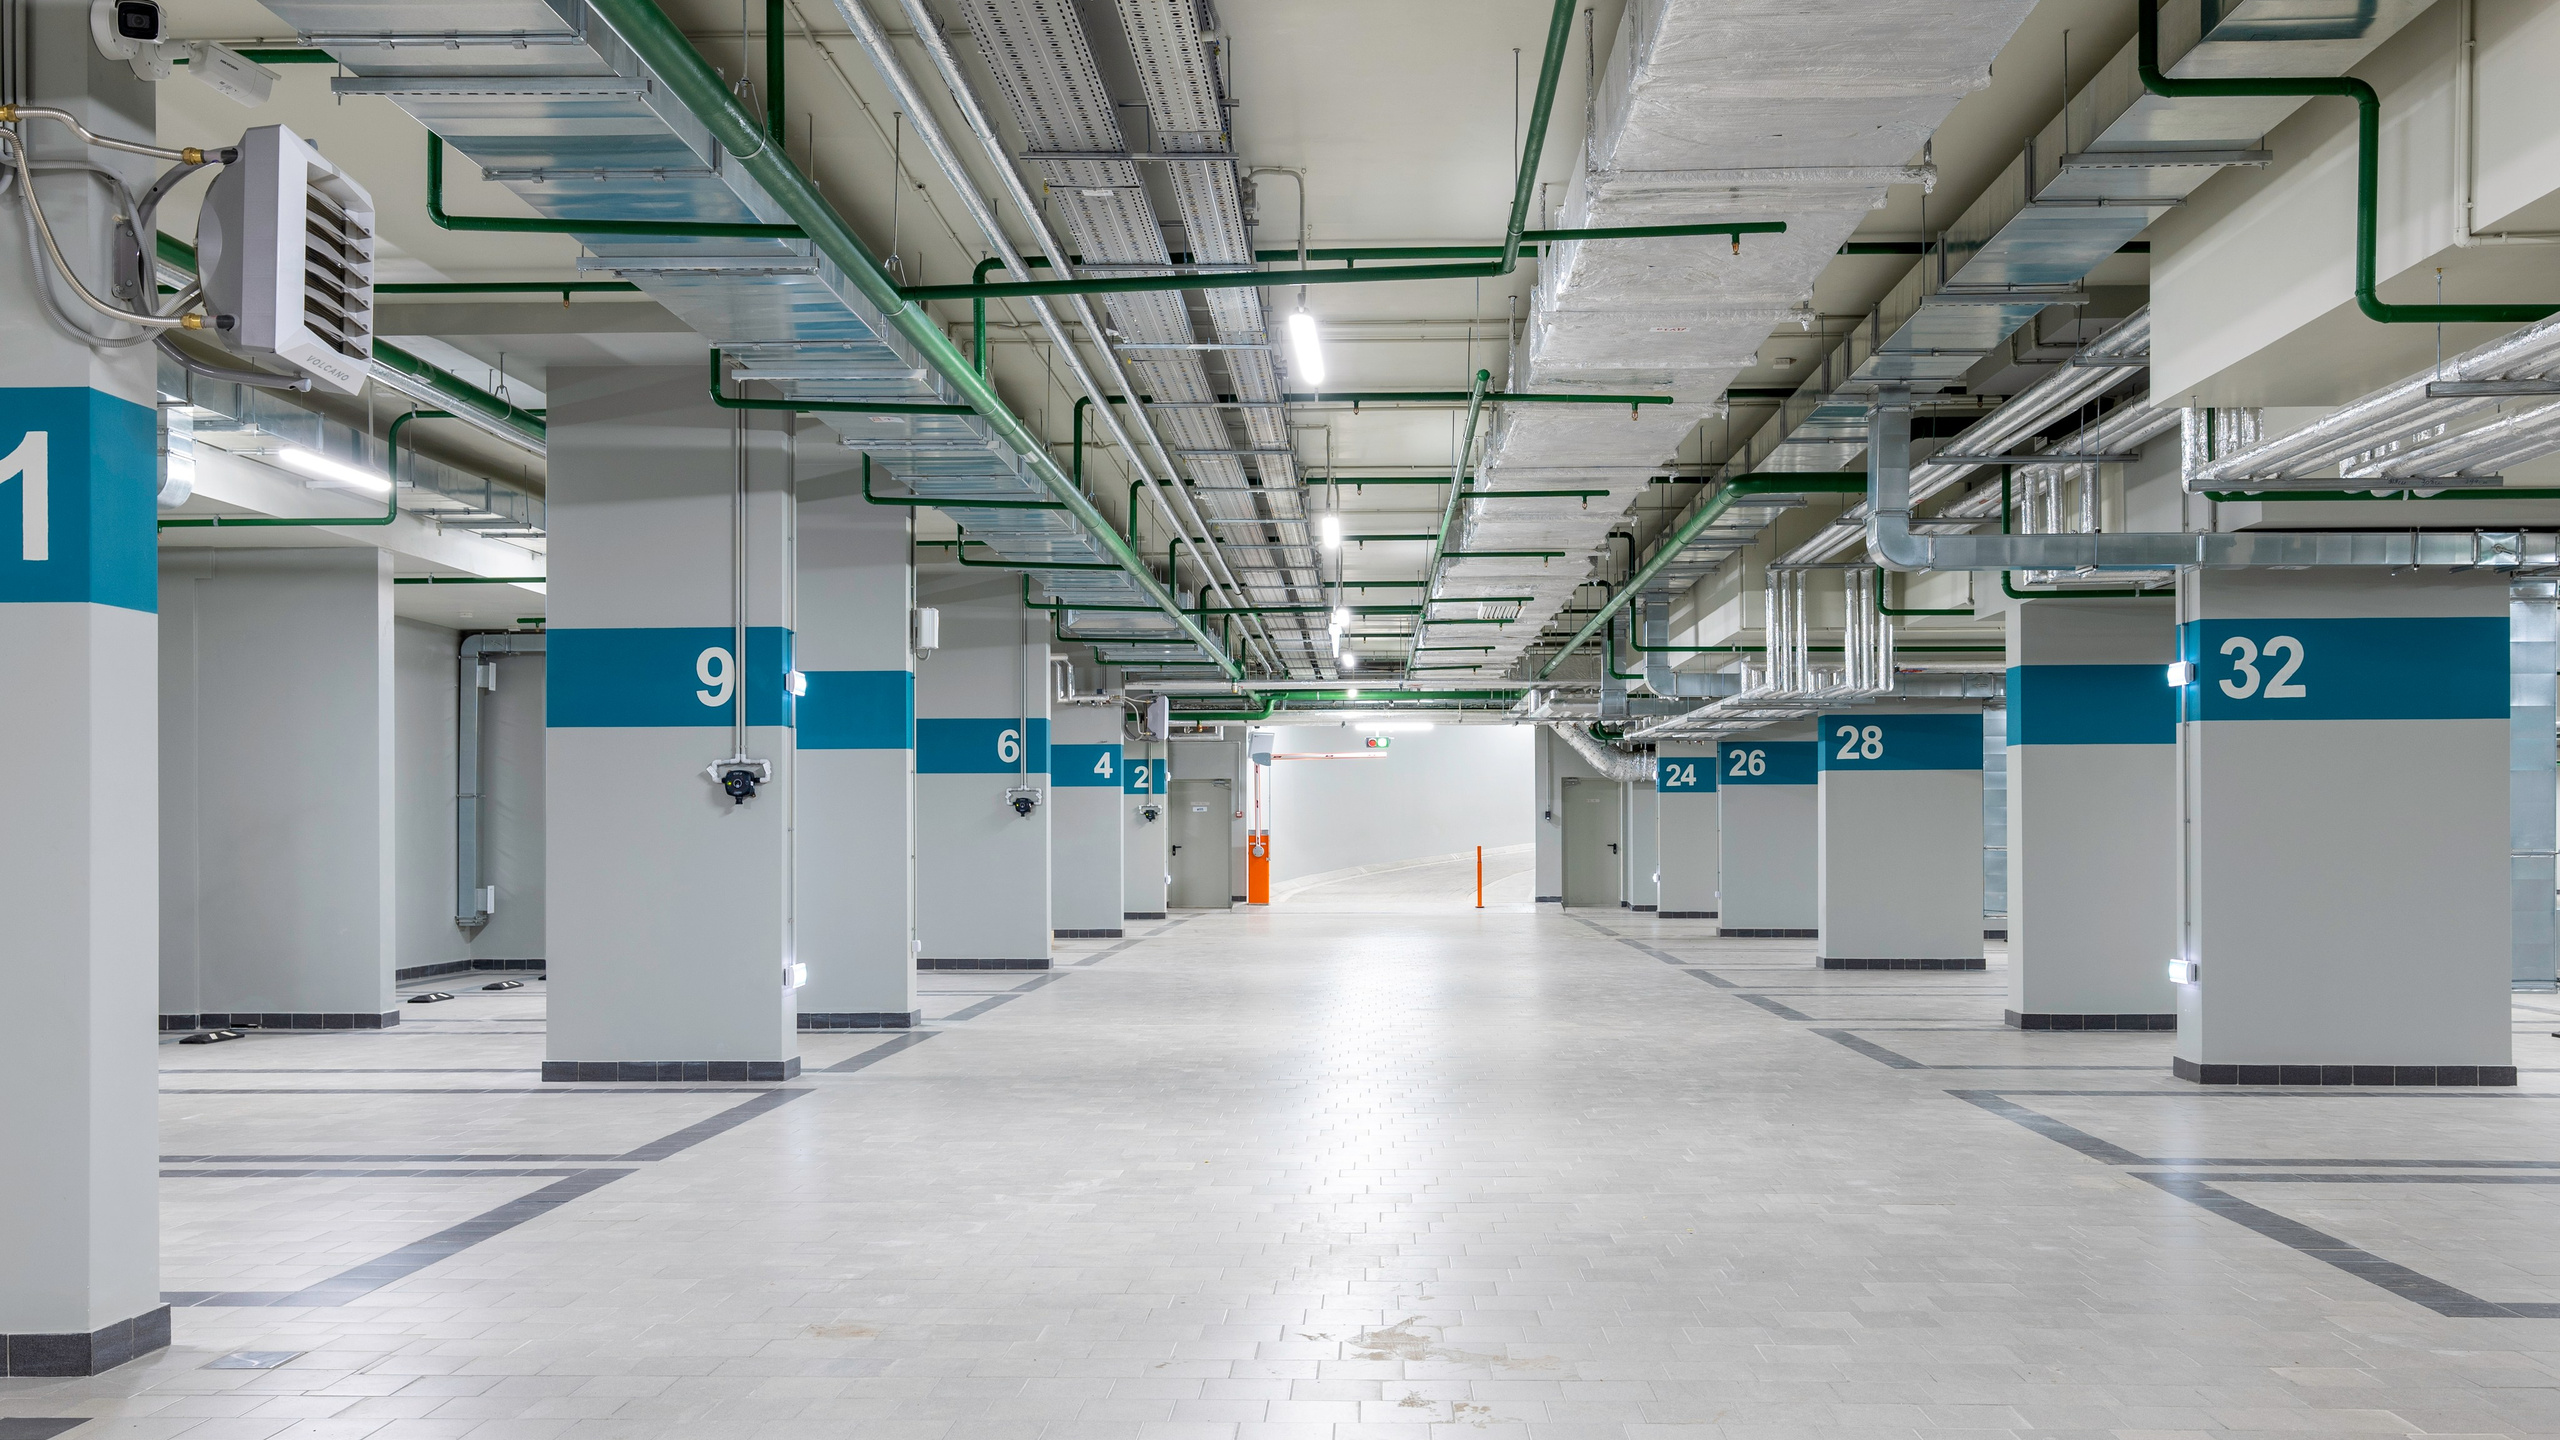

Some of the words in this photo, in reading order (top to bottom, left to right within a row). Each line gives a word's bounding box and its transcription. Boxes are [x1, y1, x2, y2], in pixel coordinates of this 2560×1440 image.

[306, 355, 350, 381] VOLCANO
[696, 647, 736, 707] 9
[2219, 636, 2306, 699] 32
[997, 729, 1020, 763] 6
[1836, 725, 1884, 760] 28
[1093, 752, 1113, 779] 4
[1133, 765, 1149, 788] 2
[1665, 764, 1697, 787] 24
[1728, 749, 1766, 777] 26
